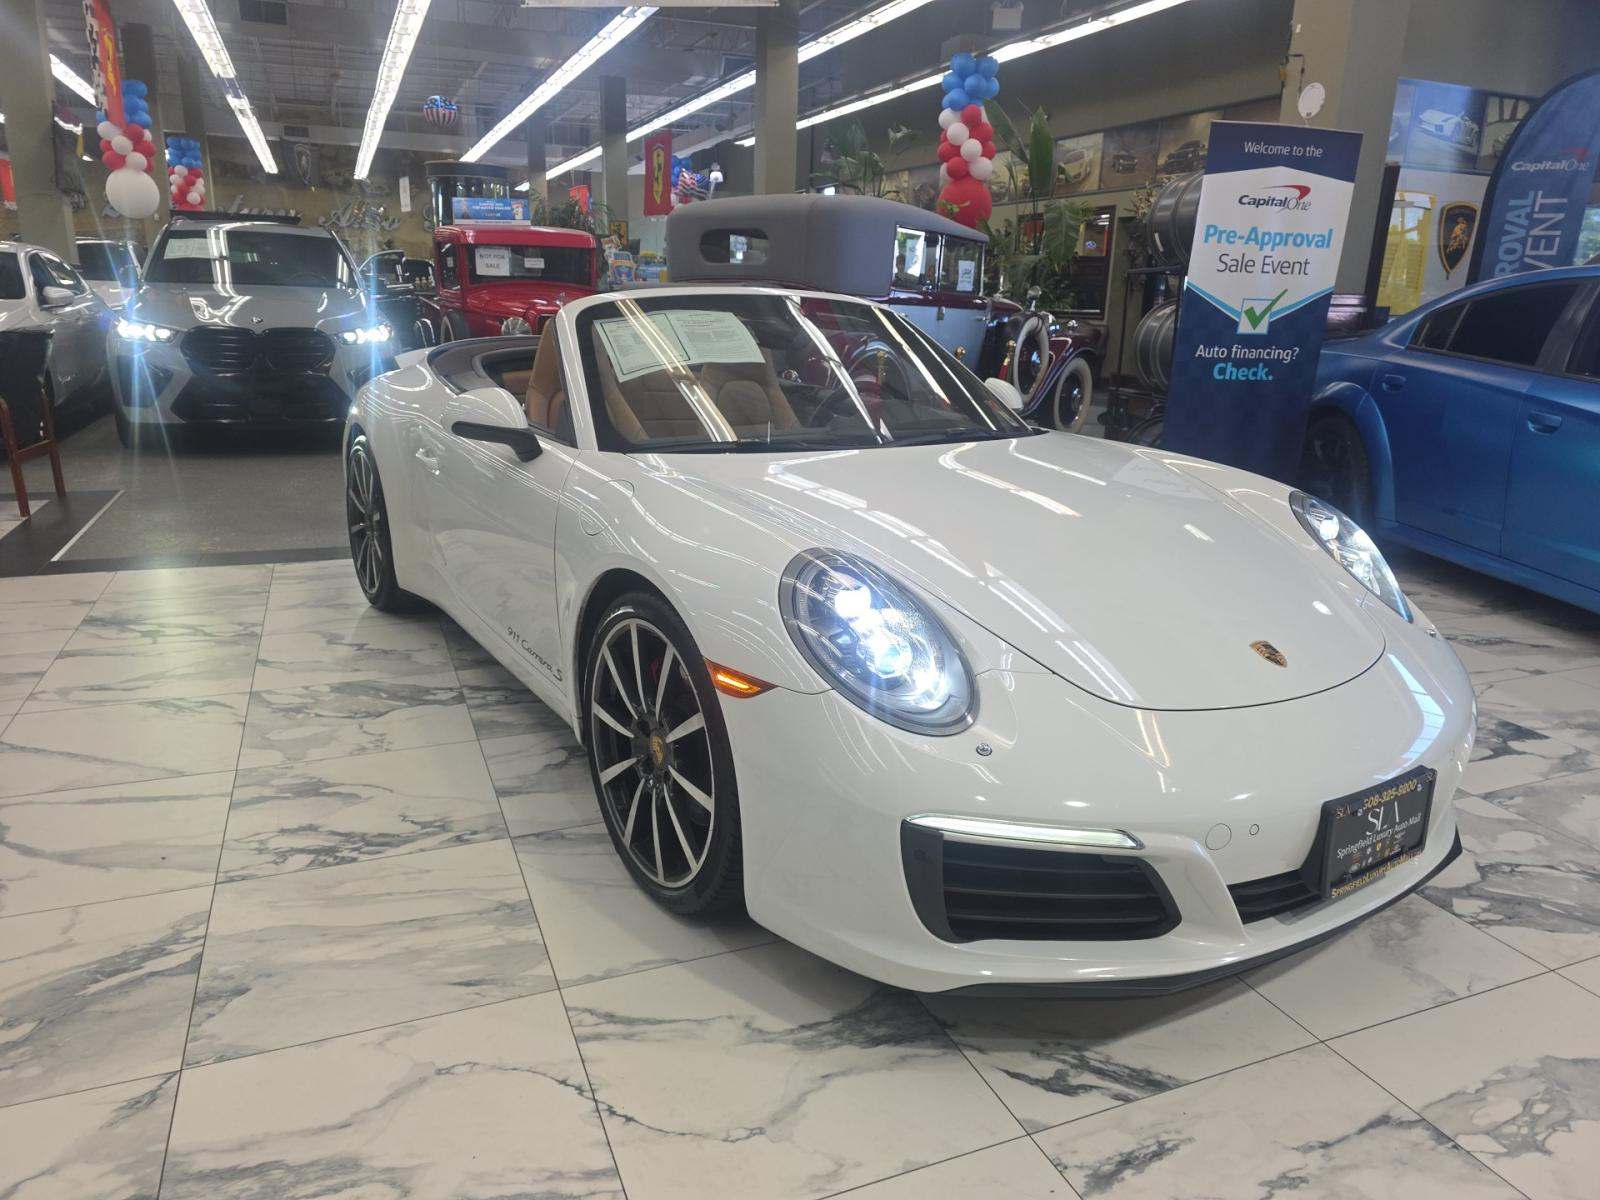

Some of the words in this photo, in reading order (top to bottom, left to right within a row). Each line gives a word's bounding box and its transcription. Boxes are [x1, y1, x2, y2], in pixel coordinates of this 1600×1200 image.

[1243, 141, 1290, 155] Welcome
[1292, 146, 1304, 156] to
[1306, 145, 1324, 157] the
[1203, 224, 1334, 251] Pre-Approval
[1216, 253, 1256, 273] Sale
[1260, 255, 1310, 275] Event
[1195, 344, 1228, 358] Auto
[1231, 344, 1300, 364] financing?
[1212, 361, 1274, 381] Check.
[507, 627, 519, 642] 911
[520, 639, 553, 673] Carrera
[552, 668, 563, 682] S
[1336, 835, 1373, 860] Springfield
